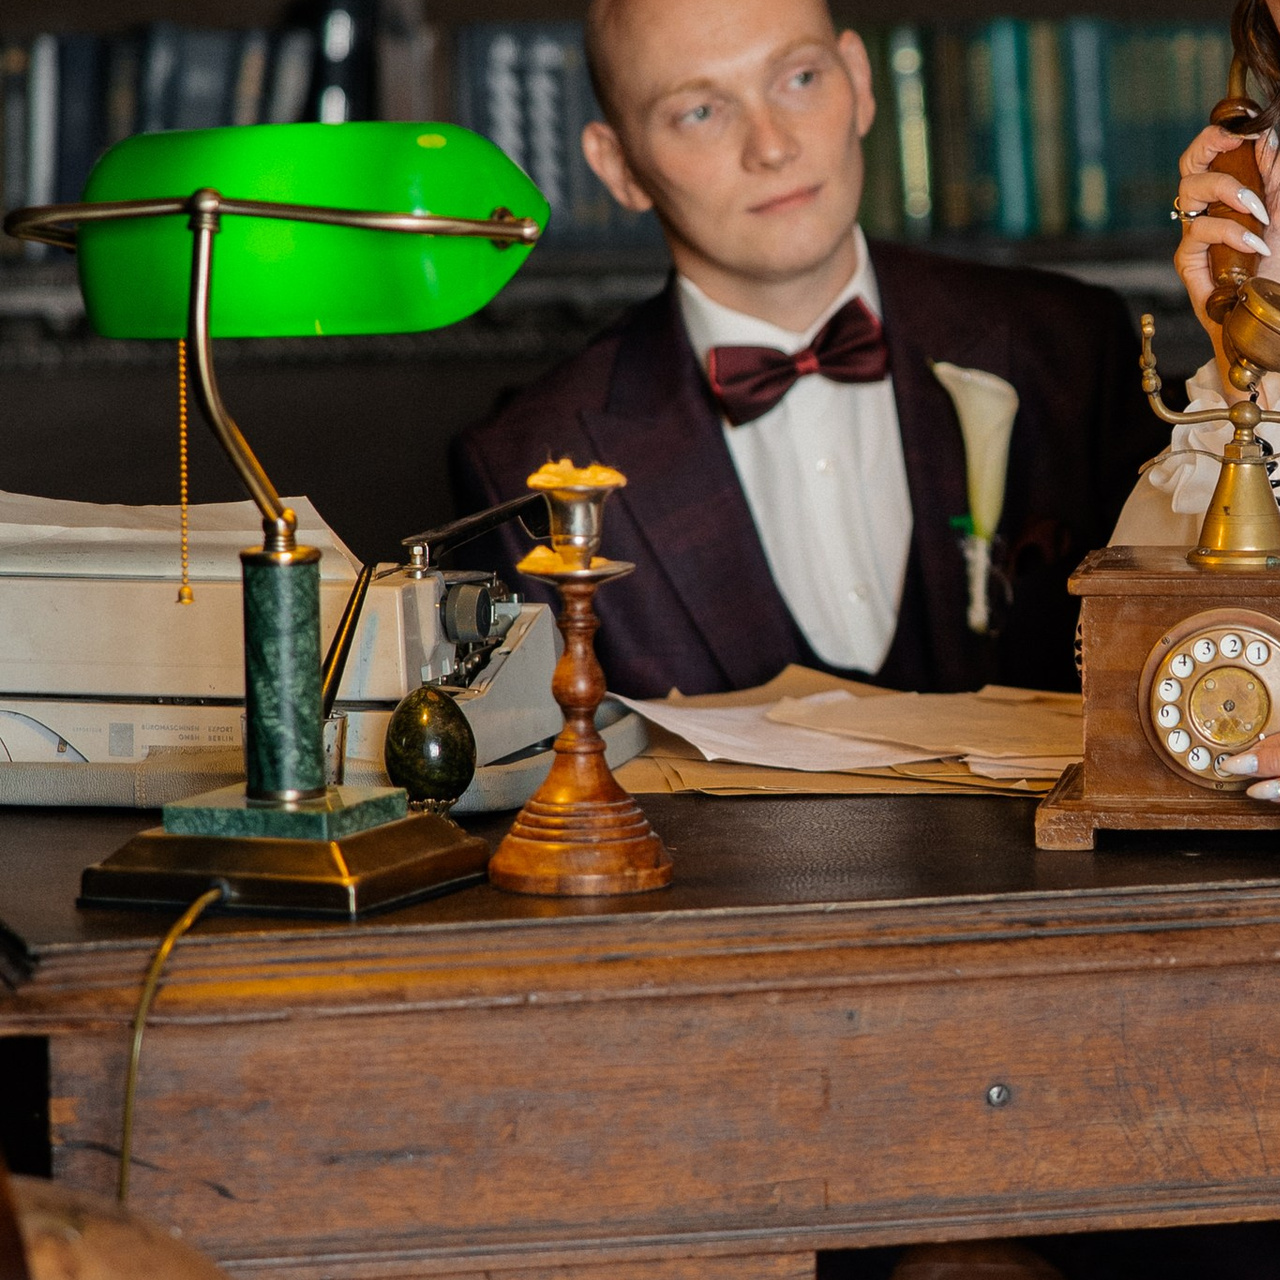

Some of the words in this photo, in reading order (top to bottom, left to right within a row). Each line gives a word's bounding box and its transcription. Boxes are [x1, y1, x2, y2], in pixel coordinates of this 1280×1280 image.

[1202, 641, 1211, 655] 3
[1229, 639, 1238, 653] 2
[1255, 646, 1262, 660] 1
[1178, 654, 1188, 667] 4
[1164, 678, 1173, 692] 5
[1160, 706, 1170, 718] 6
[1172, 731, 1181, 745] 7
[1190, 748, 1200, 762] 8
